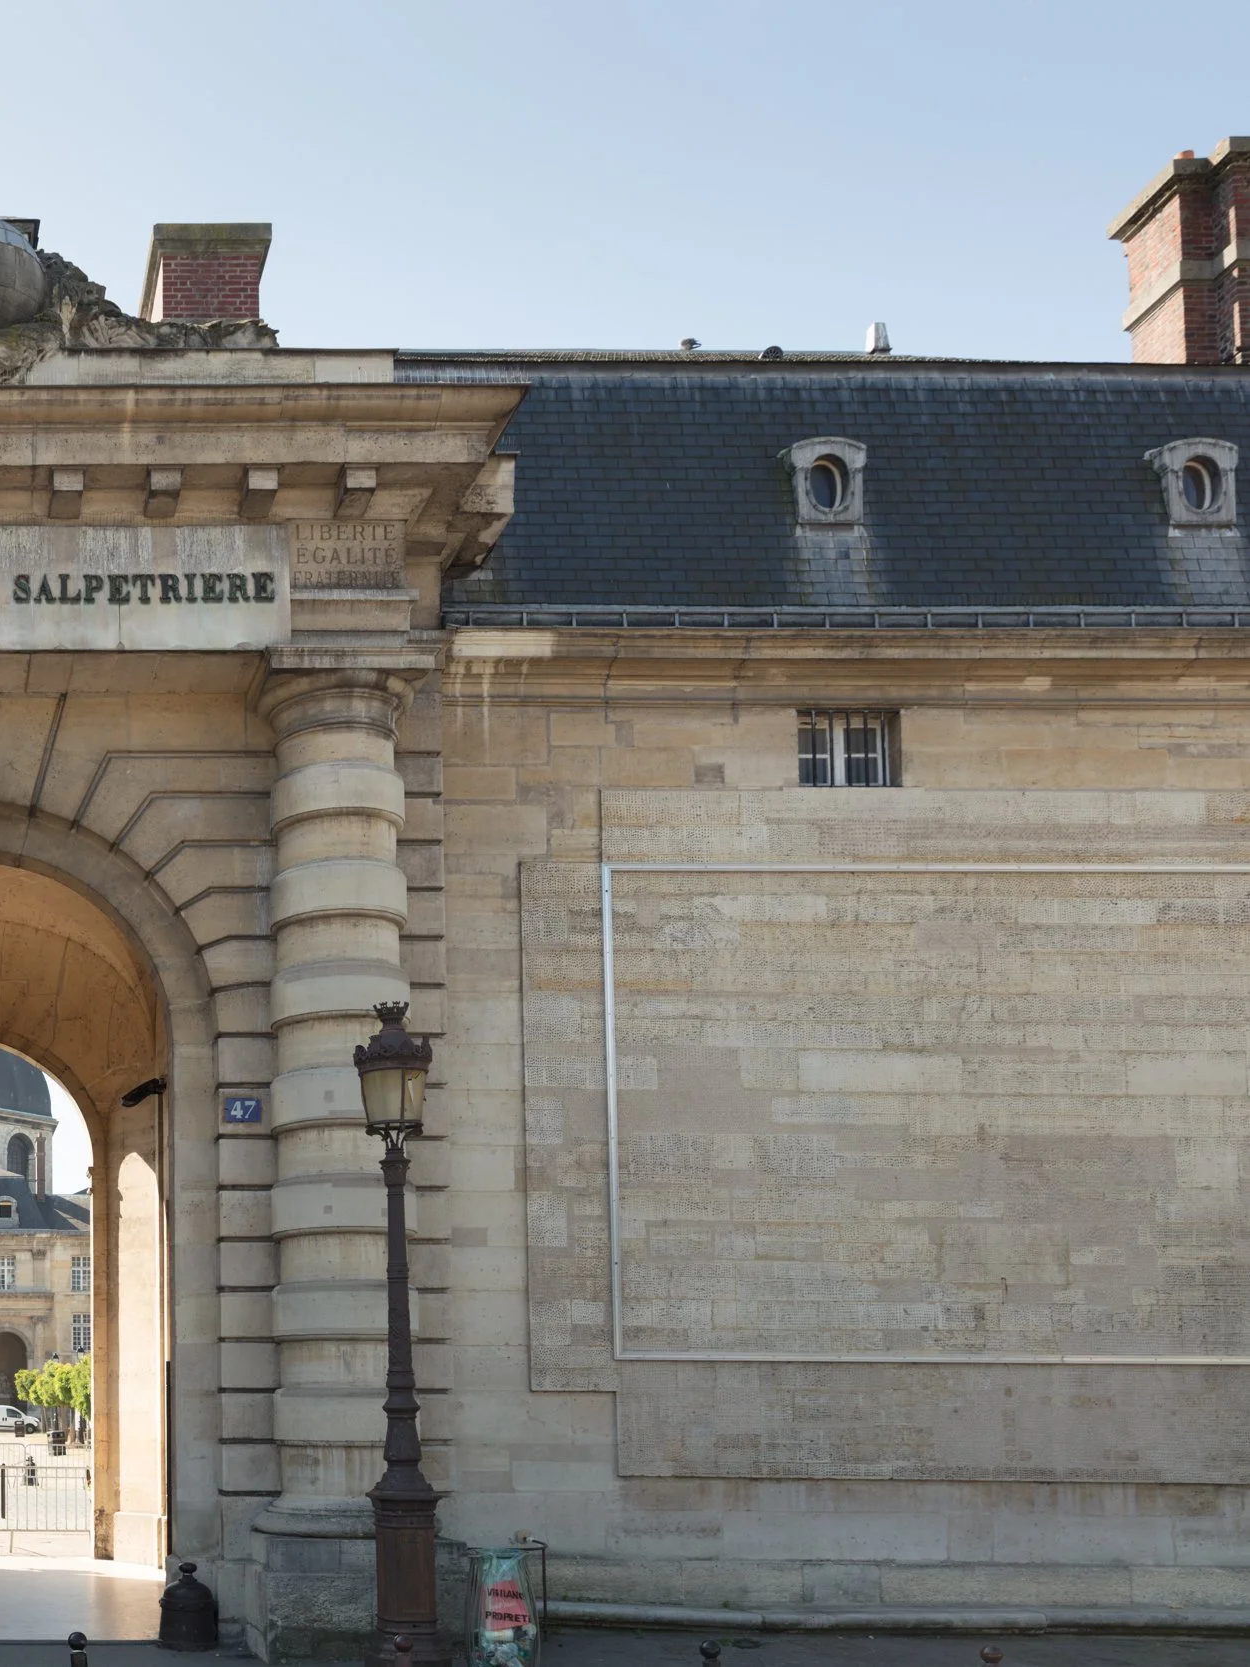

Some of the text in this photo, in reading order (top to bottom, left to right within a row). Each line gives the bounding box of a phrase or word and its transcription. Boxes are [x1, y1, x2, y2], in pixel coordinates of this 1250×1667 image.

[296, 543, 397, 564] ÉGALITÉ
[13, 571, 276, 604] SALPETRIERE
[230, 1100, 256, 1119] 47
